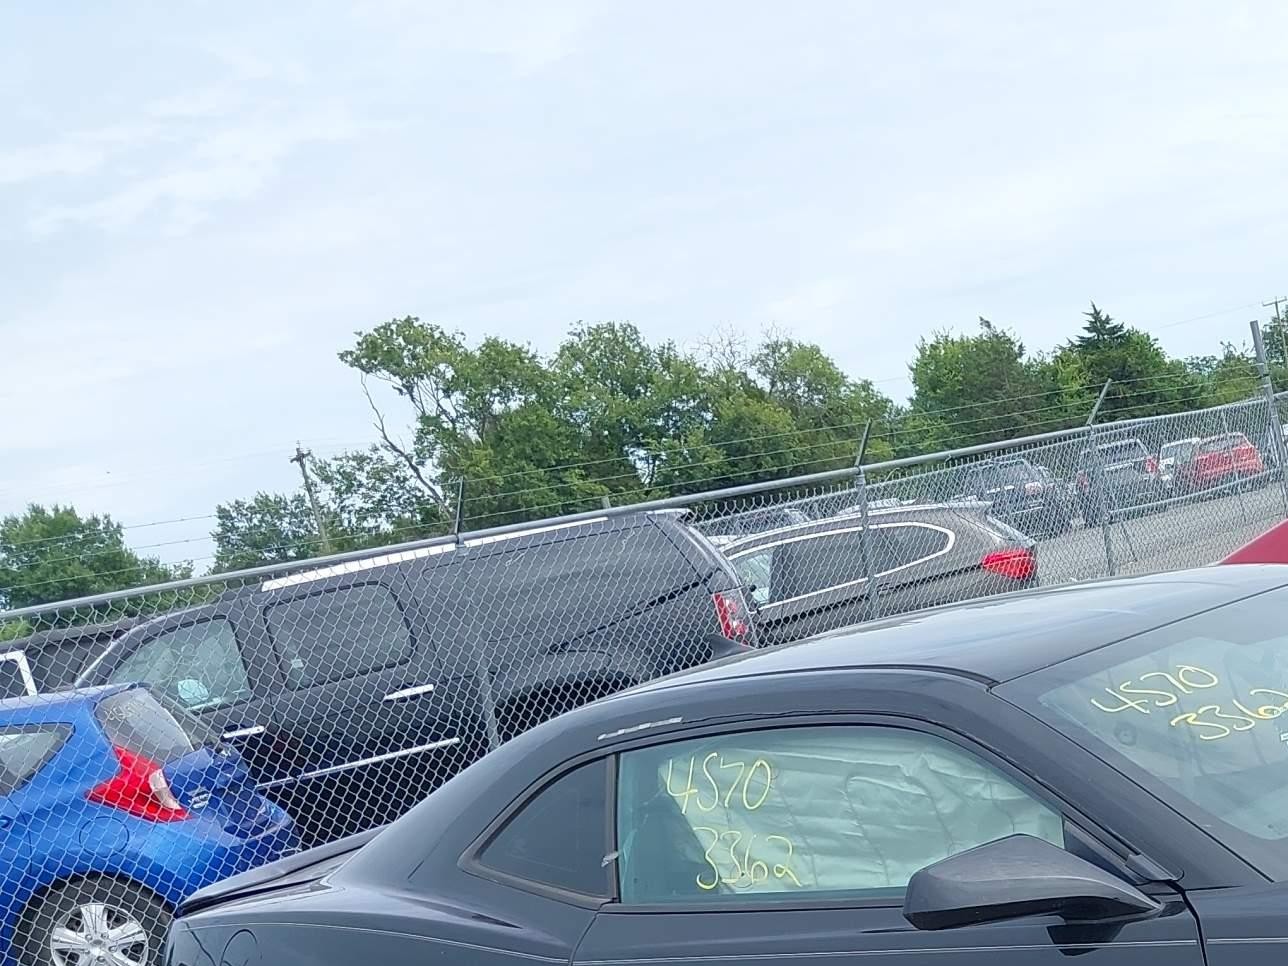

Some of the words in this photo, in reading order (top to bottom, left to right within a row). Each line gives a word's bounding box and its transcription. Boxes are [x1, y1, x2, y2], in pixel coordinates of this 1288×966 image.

[1090, 664, 1219, 715] 4570
[665, 751, 774, 816] 4570
[693, 826, 805, 891] 3362
